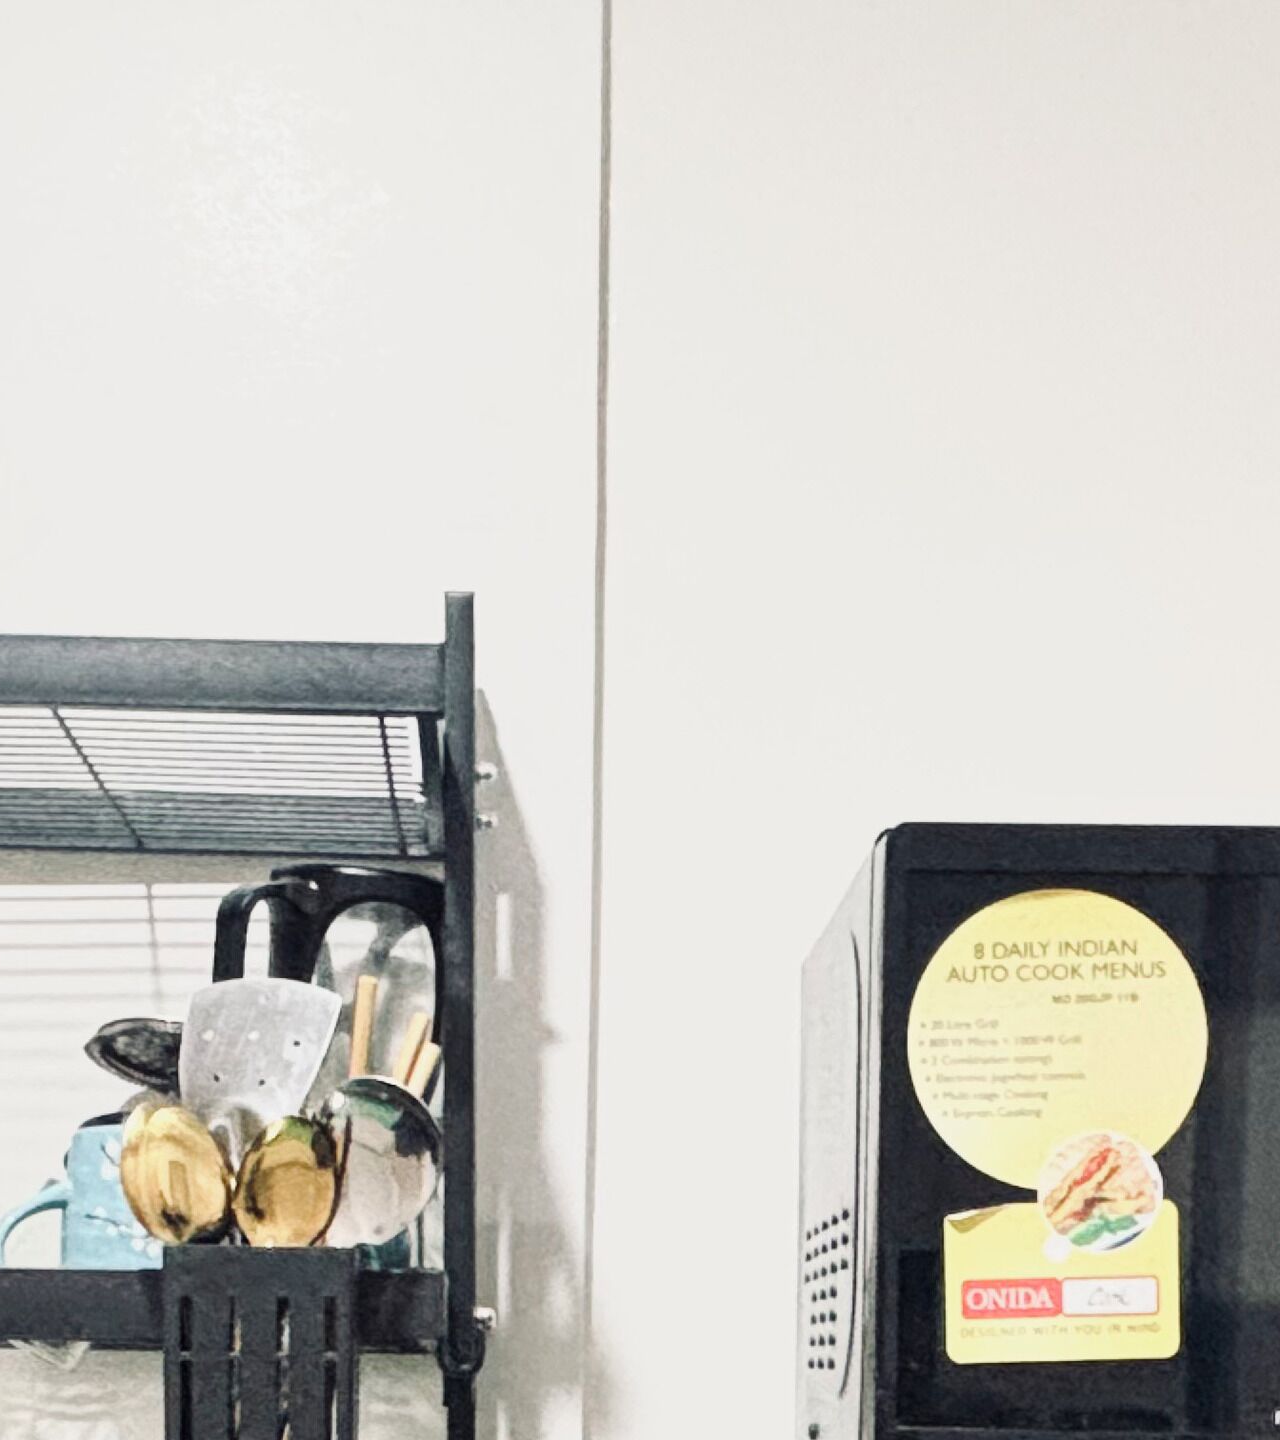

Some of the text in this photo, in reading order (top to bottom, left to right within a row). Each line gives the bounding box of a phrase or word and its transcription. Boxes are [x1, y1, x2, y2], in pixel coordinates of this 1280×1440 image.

[992, 941, 1051, 959] DAILY
[1058, 939, 1138, 957] INDIAN
[946, 961, 1167, 983] AUTO COOK MENUS
[966, 1286, 1054, 1311] ONIDA
